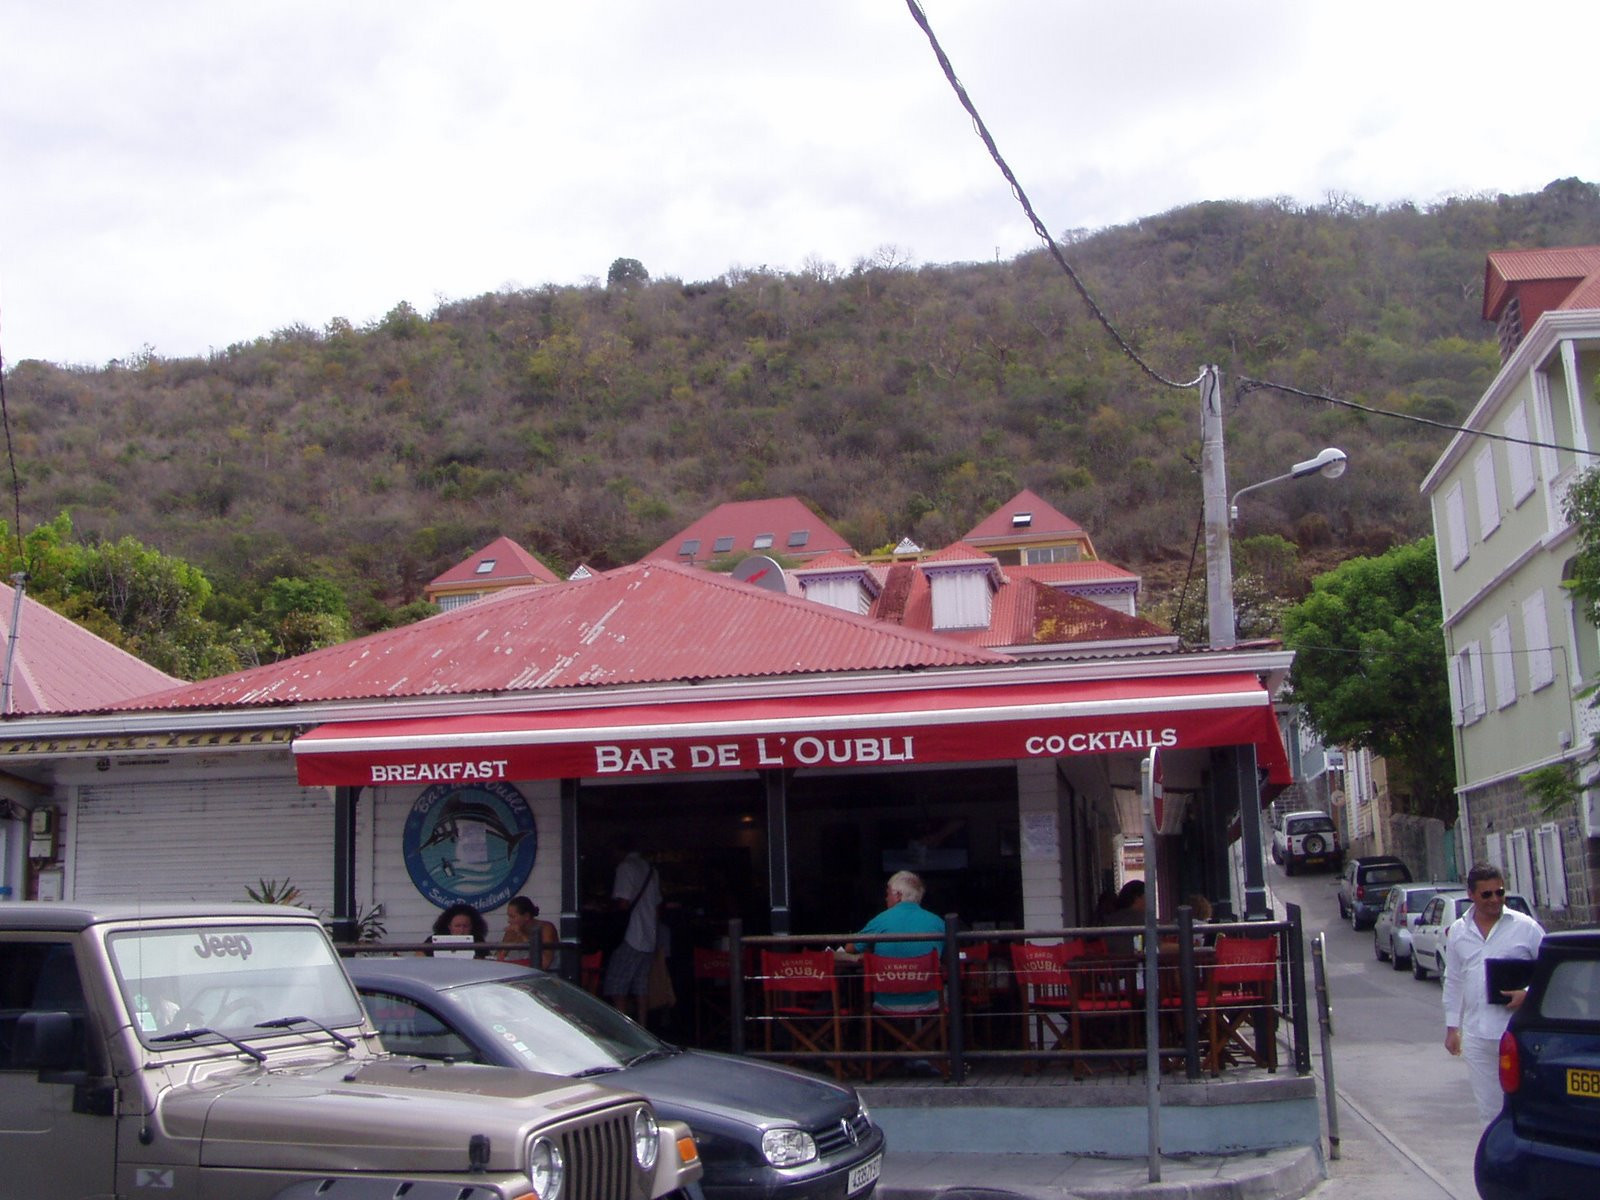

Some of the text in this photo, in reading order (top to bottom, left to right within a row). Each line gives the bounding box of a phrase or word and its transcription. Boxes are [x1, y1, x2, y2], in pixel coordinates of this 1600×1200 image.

[1025, 728, 1178, 754] COCKTAILS
[594, 736, 915, 773] BAR DE L'OUBLI
[371, 760, 507, 781] BREAKFAST
[194, 929, 252, 961] Jeep
[774, 967, 825, 980] L'OUBLI
[875, 971, 930, 982] L'OUBLI
[1571, 1072, 1600, 1093] 668
[143, 1169, 171, 1188] X
